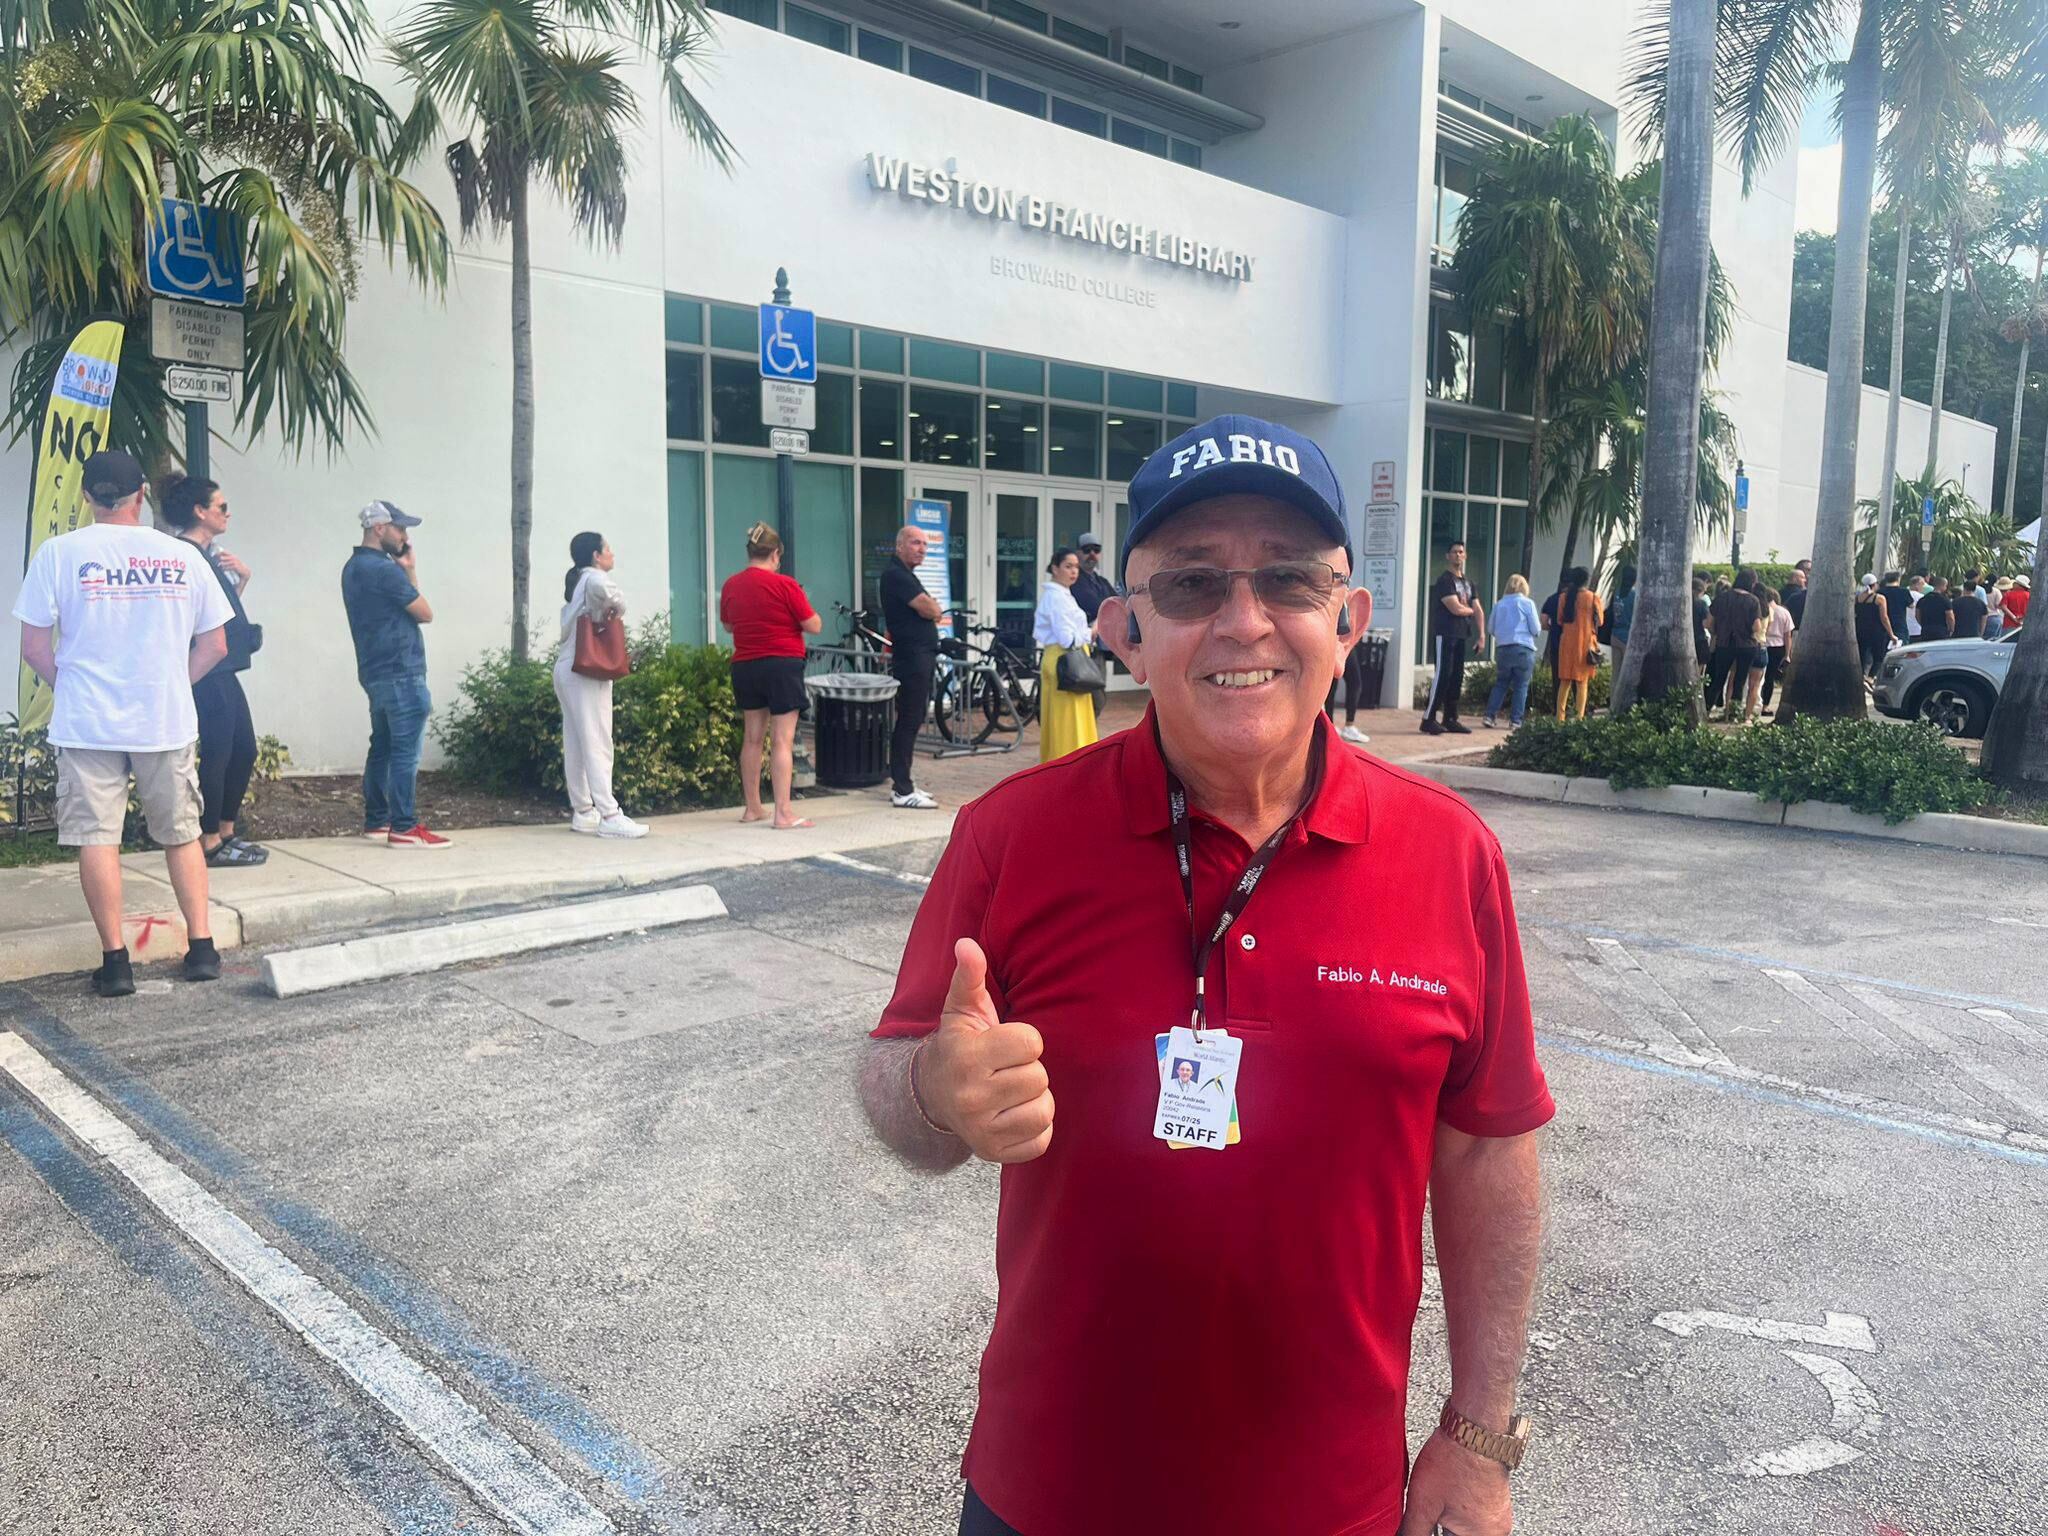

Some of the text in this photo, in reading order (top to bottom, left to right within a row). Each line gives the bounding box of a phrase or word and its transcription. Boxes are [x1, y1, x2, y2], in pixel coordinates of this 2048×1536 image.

[867, 152, 1256, 281] WESTON BRANCH LIBRARY
[990, 256, 1157, 308] BROWARD COLLEGE
[169, 304, 228, 322] PARKING BY
[176, 320, 221, 336] DISABLED
[182, 334, 216, 348] PERMIT
[187, 348, 211, 361] ONLY
[171, 376, 229, 393] $250.00 FINE
[50, 411, 101, 464] NO
[1169, 434, 1300, 478] FABIO
[129, 556, 186, 569] Rolando
[79, 562, 186, 585] CHAVEZ
[1369, 968, 1384, 985] A.
[1389, 971, 1447, 995] Andrade
[1181, 1115, 1201, 1125] 07/25
[1163, 1122, 1217, 1142] STAFF
